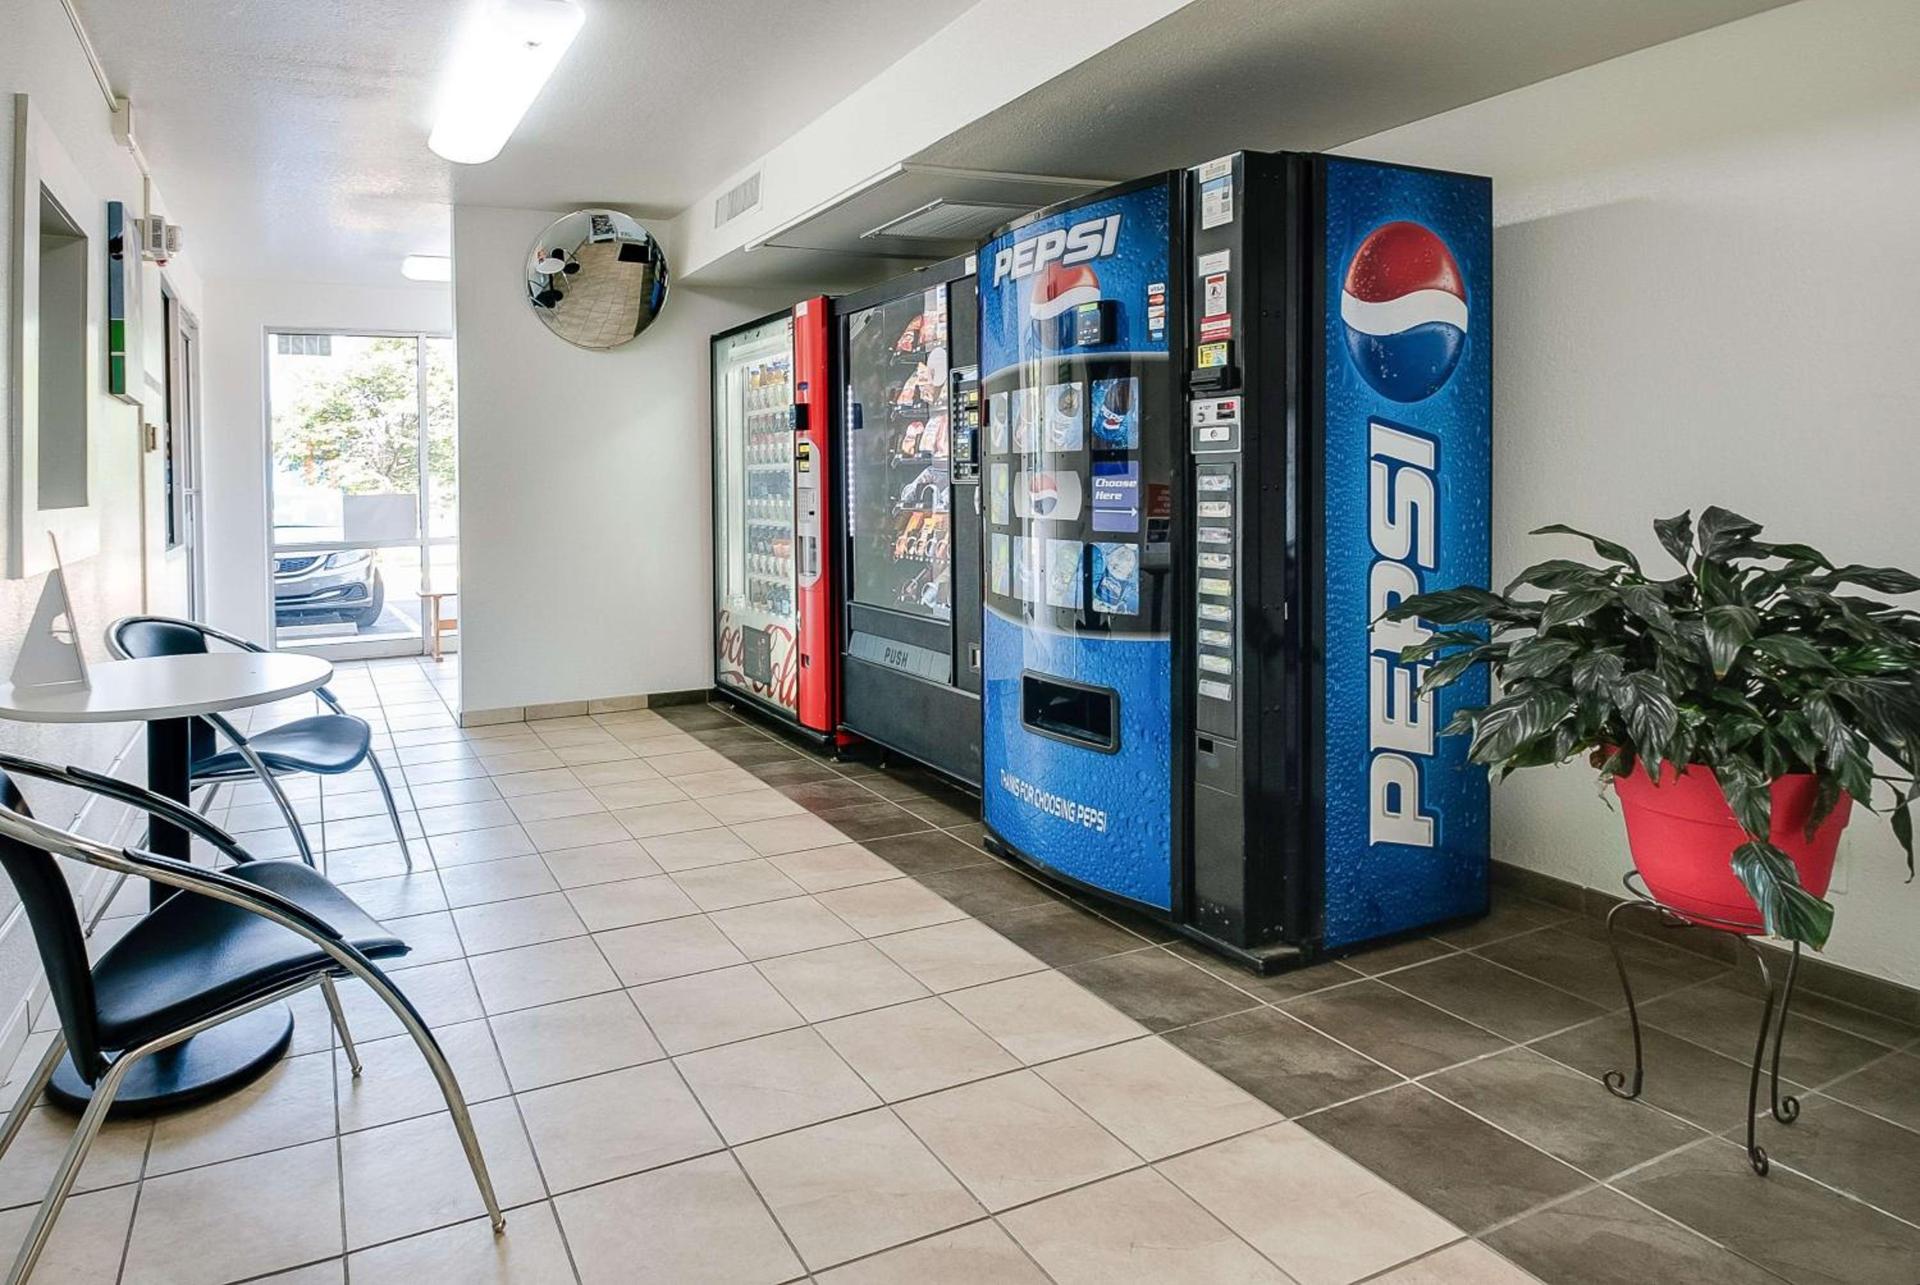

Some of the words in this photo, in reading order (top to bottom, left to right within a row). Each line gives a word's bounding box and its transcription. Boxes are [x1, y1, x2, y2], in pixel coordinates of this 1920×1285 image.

[993, 213, 1122, 289] PEPSI
[1094, 477, 1138, 489] Choose
[1094, 490, 1123, 501] Here
[1369, 422, 1436, 849] PEPSI
[883, 646, 909, 668] PUSH
[1019, 780, 1034, 805] FOR
[1034, 787, 1077, 823] CHOOSING
[1077, 803, 1107, 833] PEPSI
